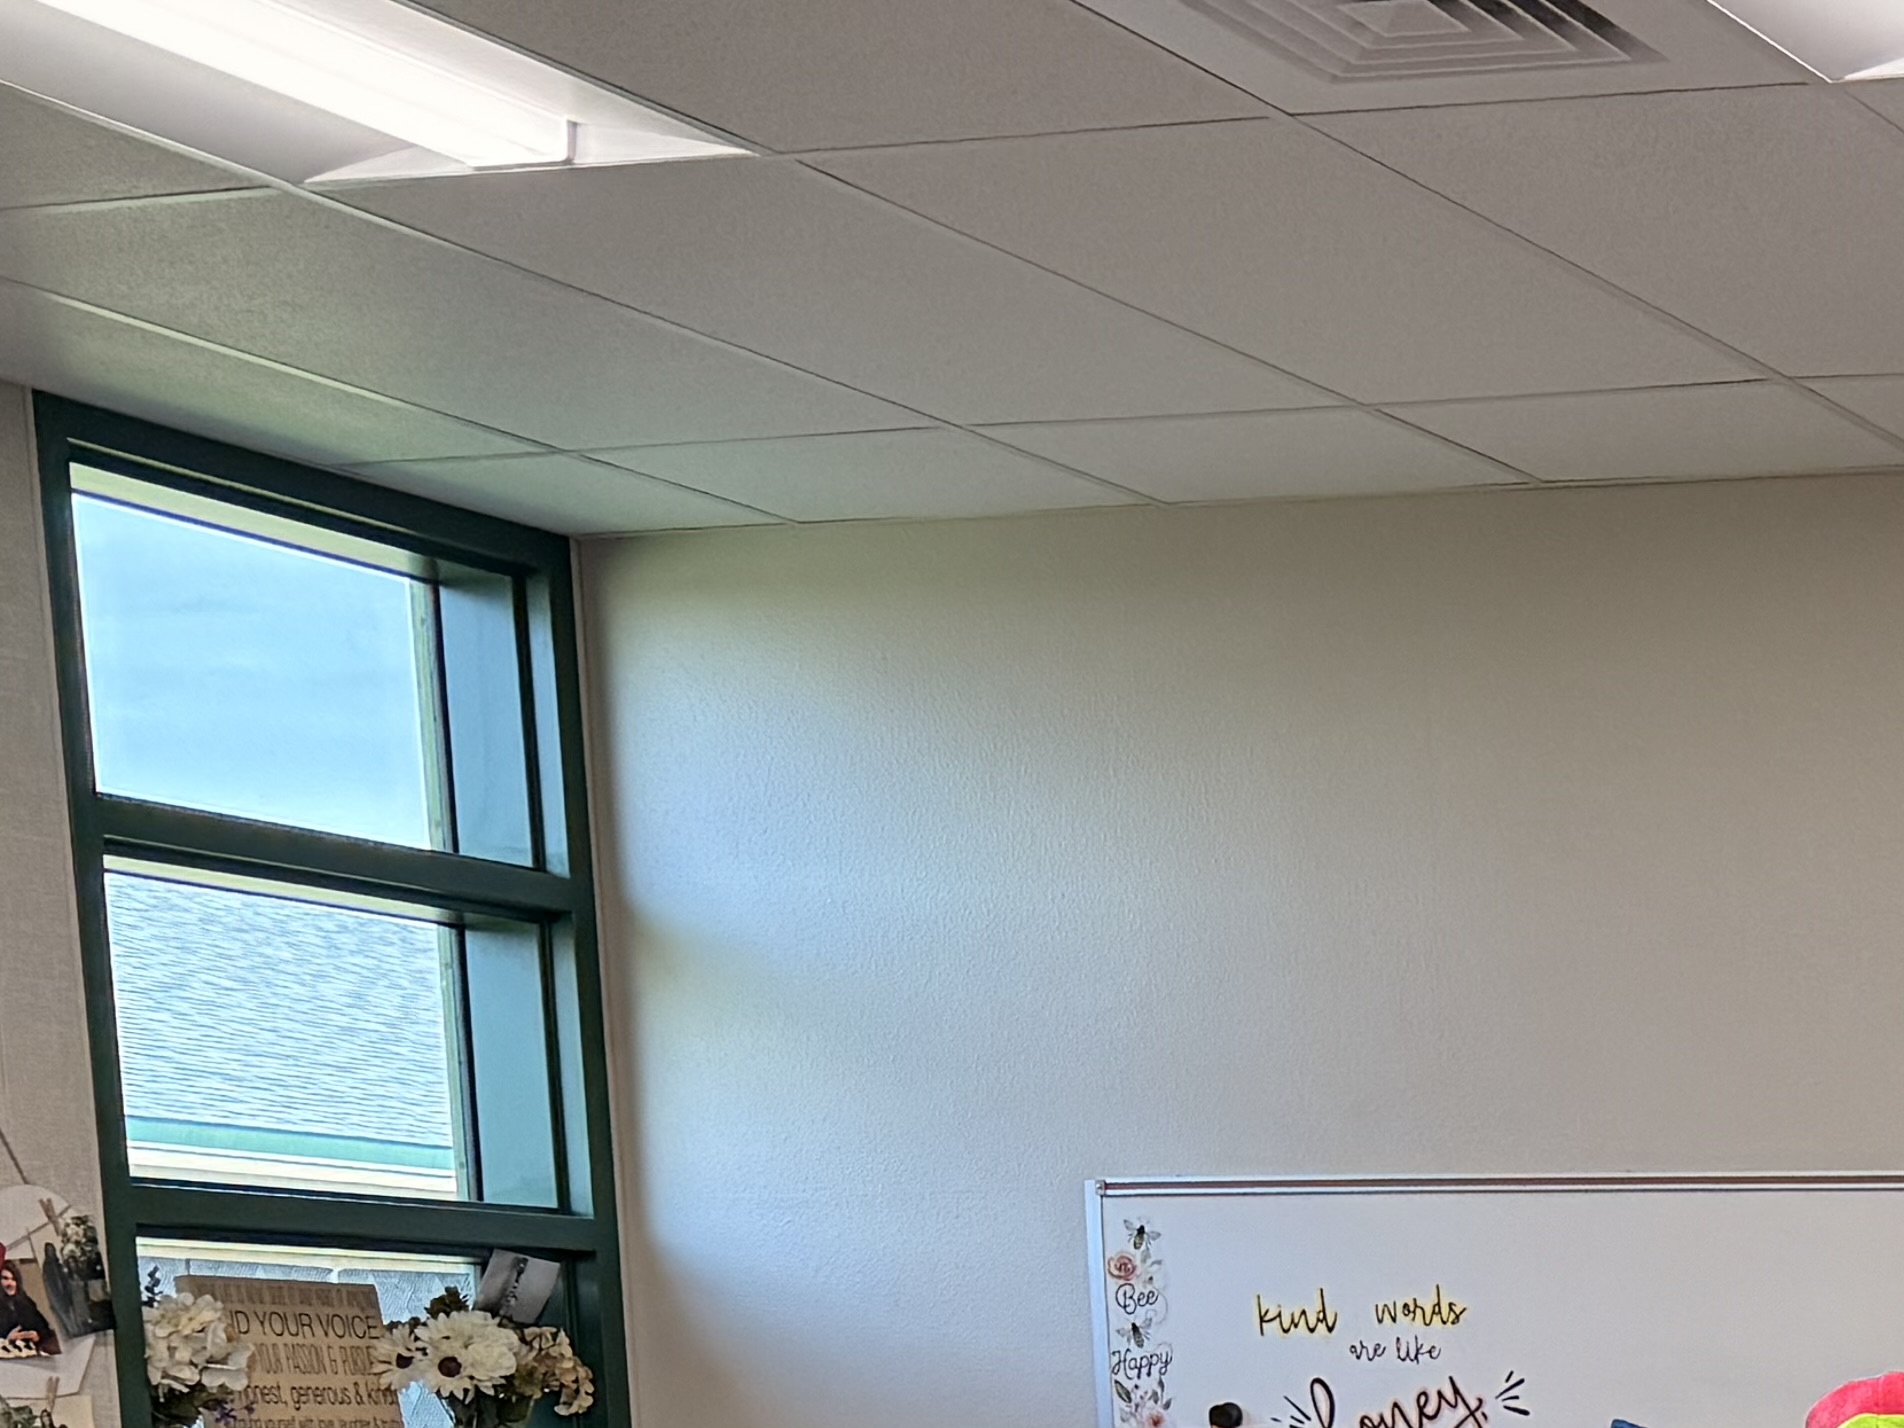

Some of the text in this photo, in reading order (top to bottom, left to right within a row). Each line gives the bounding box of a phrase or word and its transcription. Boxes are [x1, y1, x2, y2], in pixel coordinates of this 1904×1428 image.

[1115, 1283, 1158, 1315] Bee
[1257, 1284, 1467, 1336] kind words
[254, 1311, 380, 1339] YOUR VOICE
[1111, 1348, 1173, 1380] Happy
[1349, 1334, 1441, 1364] are like
